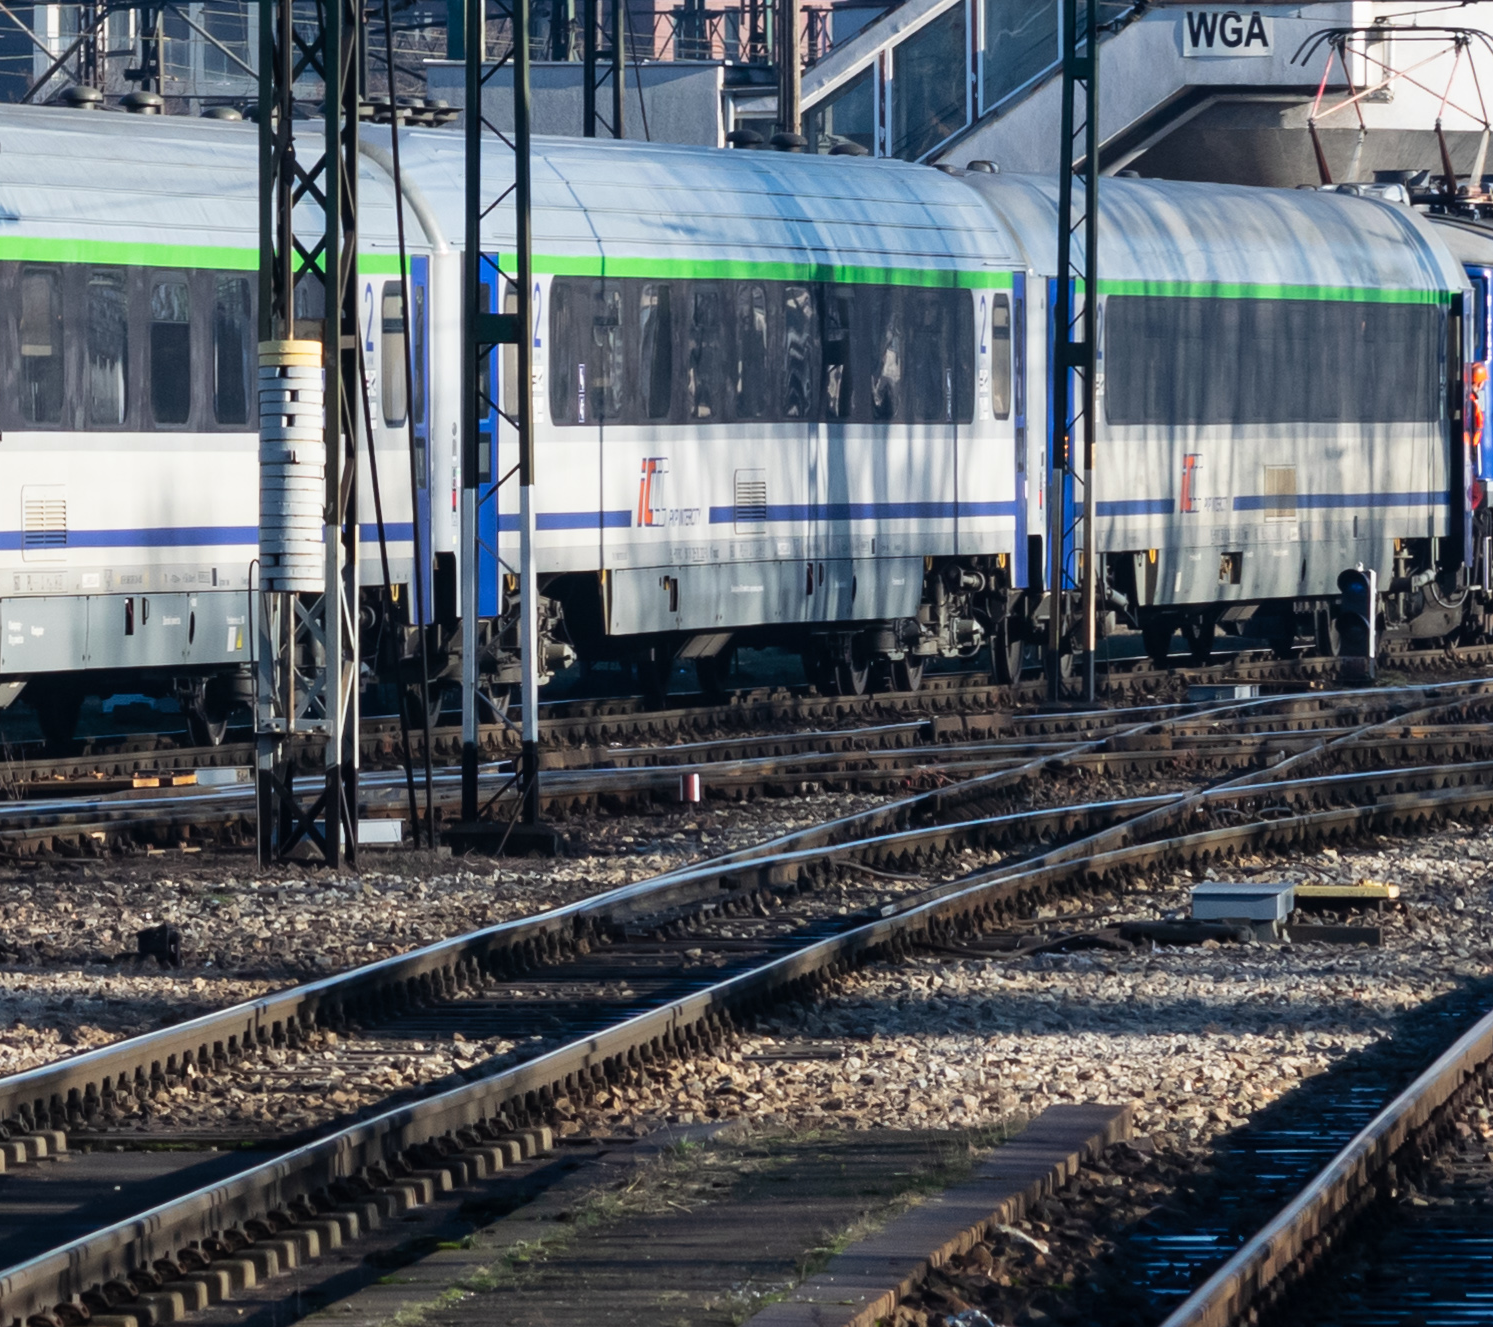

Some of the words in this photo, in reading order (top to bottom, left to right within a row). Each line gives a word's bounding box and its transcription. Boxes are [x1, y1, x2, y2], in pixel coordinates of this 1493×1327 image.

[1186, 10, 1269, 48] WGA
[365, 282, 374, 352] 2
[533, 282, 541, 348] 2
